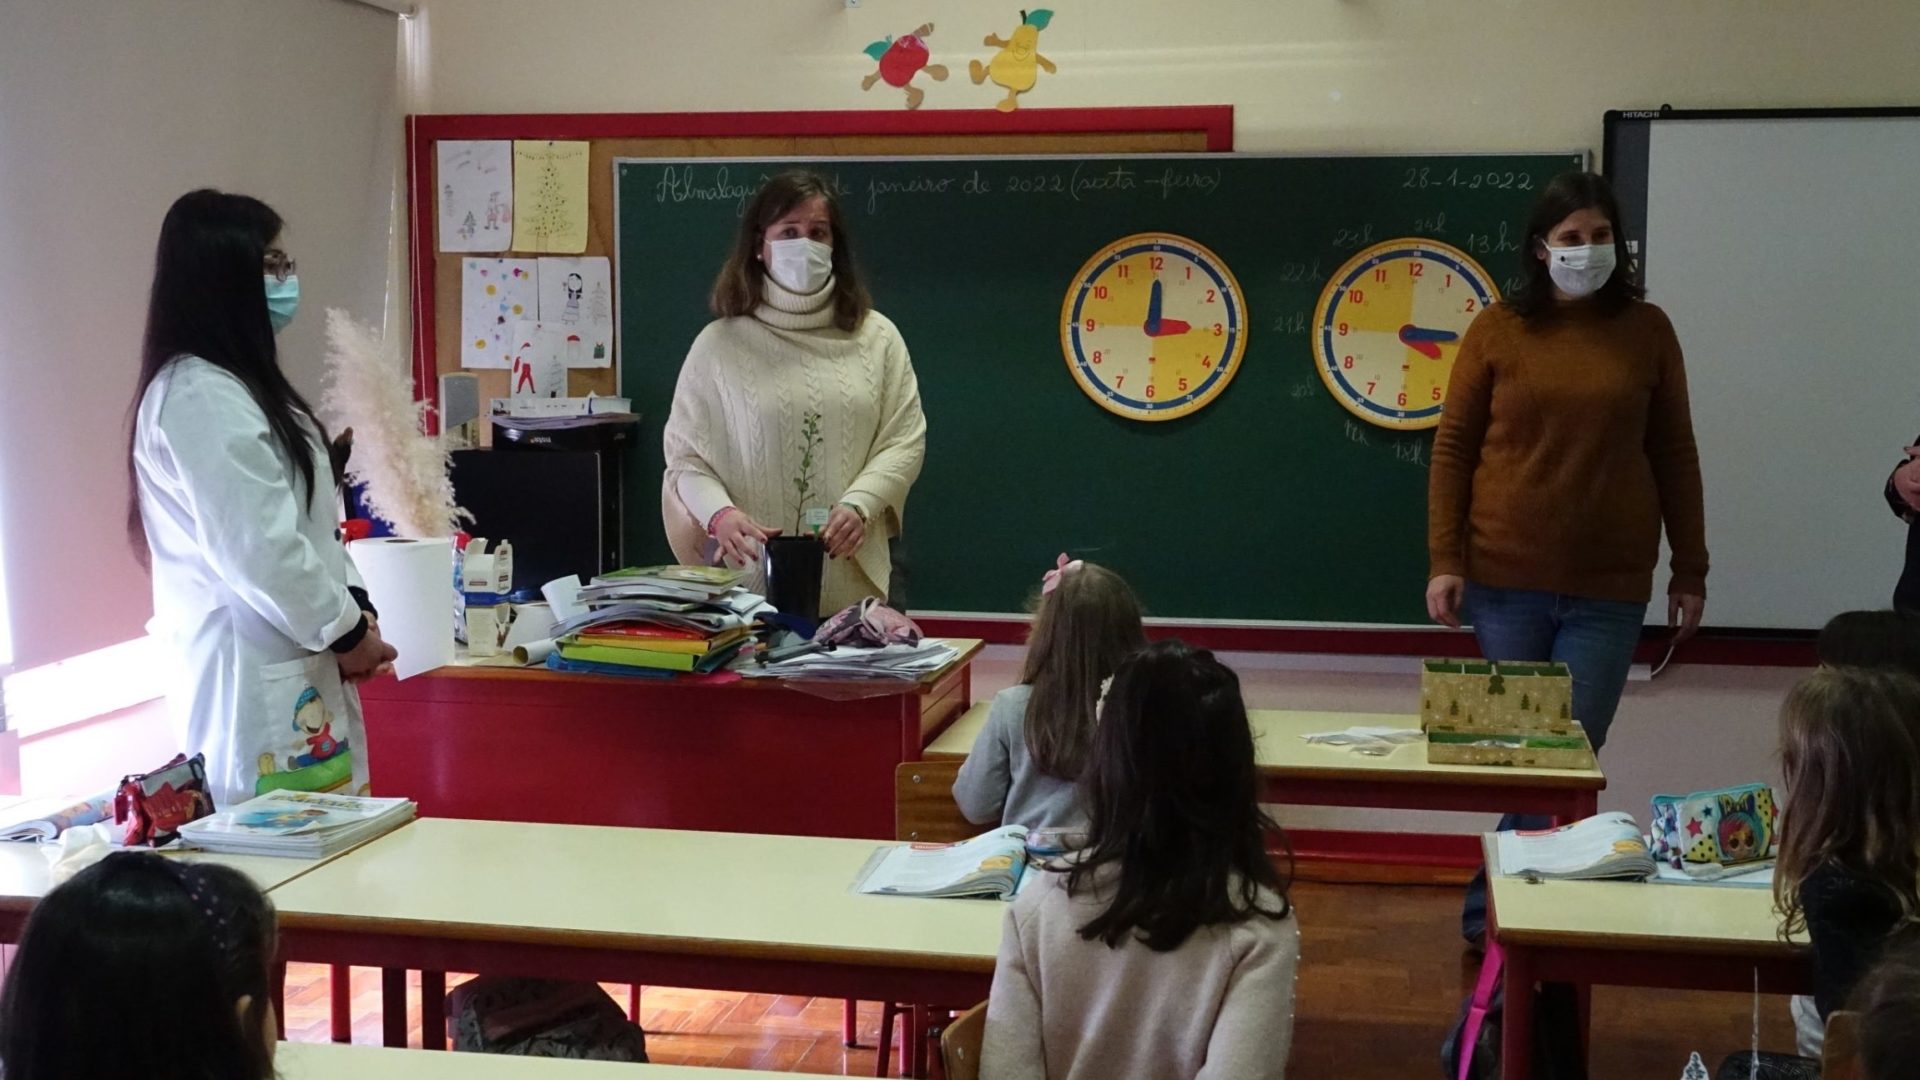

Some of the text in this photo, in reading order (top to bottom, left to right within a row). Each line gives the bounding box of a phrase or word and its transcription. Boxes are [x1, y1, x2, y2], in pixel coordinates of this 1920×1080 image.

[1402, 167, 1534, 191] 28-1-2022
[656, 165, 770, 218] Almalagu
[867, 173, 955, 215] janeiro
[962, 169, 993, 195] de
[1006, 175, 1065, 193] 2022
[1466, 220, 1520, 254] 13h
[1149, 257, 1164, 271] 12
[1409, 263, 1423, 277] 12
[1118, 265, 1129, 278] 11
[1185, 266, 1191, 280] 1
[1375, 269, 1386, 283] 11
[1445, 274, 1451, 288] 1
[1093, 286, 1108, 299] 10
[1206, 289, 1215, 303] 2
[1349, 290, 1363, 304] 10
[1465, 298, 1475, 312] 2
[1086, 318, 1095, 332] 9
[1213, 323, 1222, 336] 3
[1339, 323, 1348, 336] 9
[1092, 351, 1102, 364] 8
[1202, 355, 1211, 369] 4
[1344, 355, 1353, 369] 8
[1115, 376, 1124, 389] 7
[1178, 378, 1187, 391] 5
[1366, 382, 1376, 395] 7
[1146, 385, 1155, 398] 6
[1432, 387, 1441, 401] 5
[1397, 393, 1407, 406] 6
